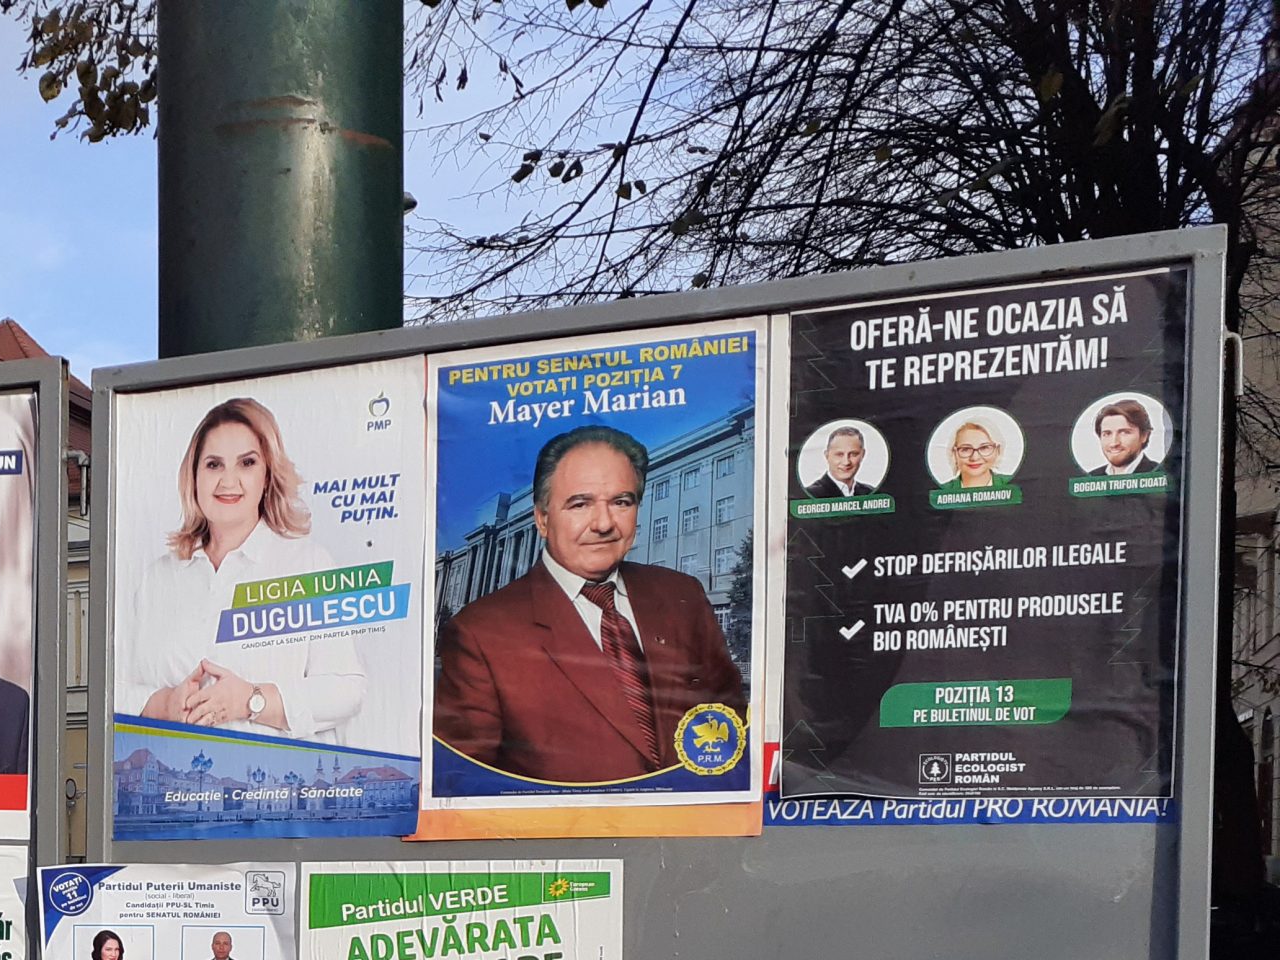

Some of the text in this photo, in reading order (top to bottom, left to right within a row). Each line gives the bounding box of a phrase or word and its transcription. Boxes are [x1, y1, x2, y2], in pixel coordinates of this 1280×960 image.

[851, 285, 1128, 351] OFERĂ-NE OCAZIA SĂ
[449, 336, 748, 385] PENTRU SENATUL ROMÂNIEI
[866, 335, 1108, 390] TE REPREZENTĂM!
[508, 365, 682, 397] VOTAȚI POZIȚIA 7
[488, 385, 686, 428] Mayer Marian
[367, 420, 391, 430] PMP
[313, 474, 400, 495] MAI MULT
[331, 490, 395, 508] CU MAI
[937, 490, 1011, 505] ADRIANA ROMANOV
[340, 506, 398, 525] PUȚIN.
[874, 543, 1127, 577] STOP DEFRIȘĂRILOR ILEGALE
[246, 569, 381, 604] LIGIA IUNIA
[233, 591, 395, 637] DUGULESCU
[874, 592, 1123, 624] TVA 0% PENTRU PRODUSELE
[873, 625, 1007, 652] BIO ROMÂNEȘTI
[935, 685, 1014, 707] POZIȚIA 13
[913, 706, 1036, 723] PE BULETINUL DE VOT
[955, 752, 1017, 762] PARTIDUL
[955, 762, 1026, 774] ECOLOGIST
[66, 890, 78, 900] 11
[98, 882, 241, 892] Partidul Puterii Umaniste
[252, 897, 279, 907] PPU
[341, 884, 509, 922] Partidul VERDE
